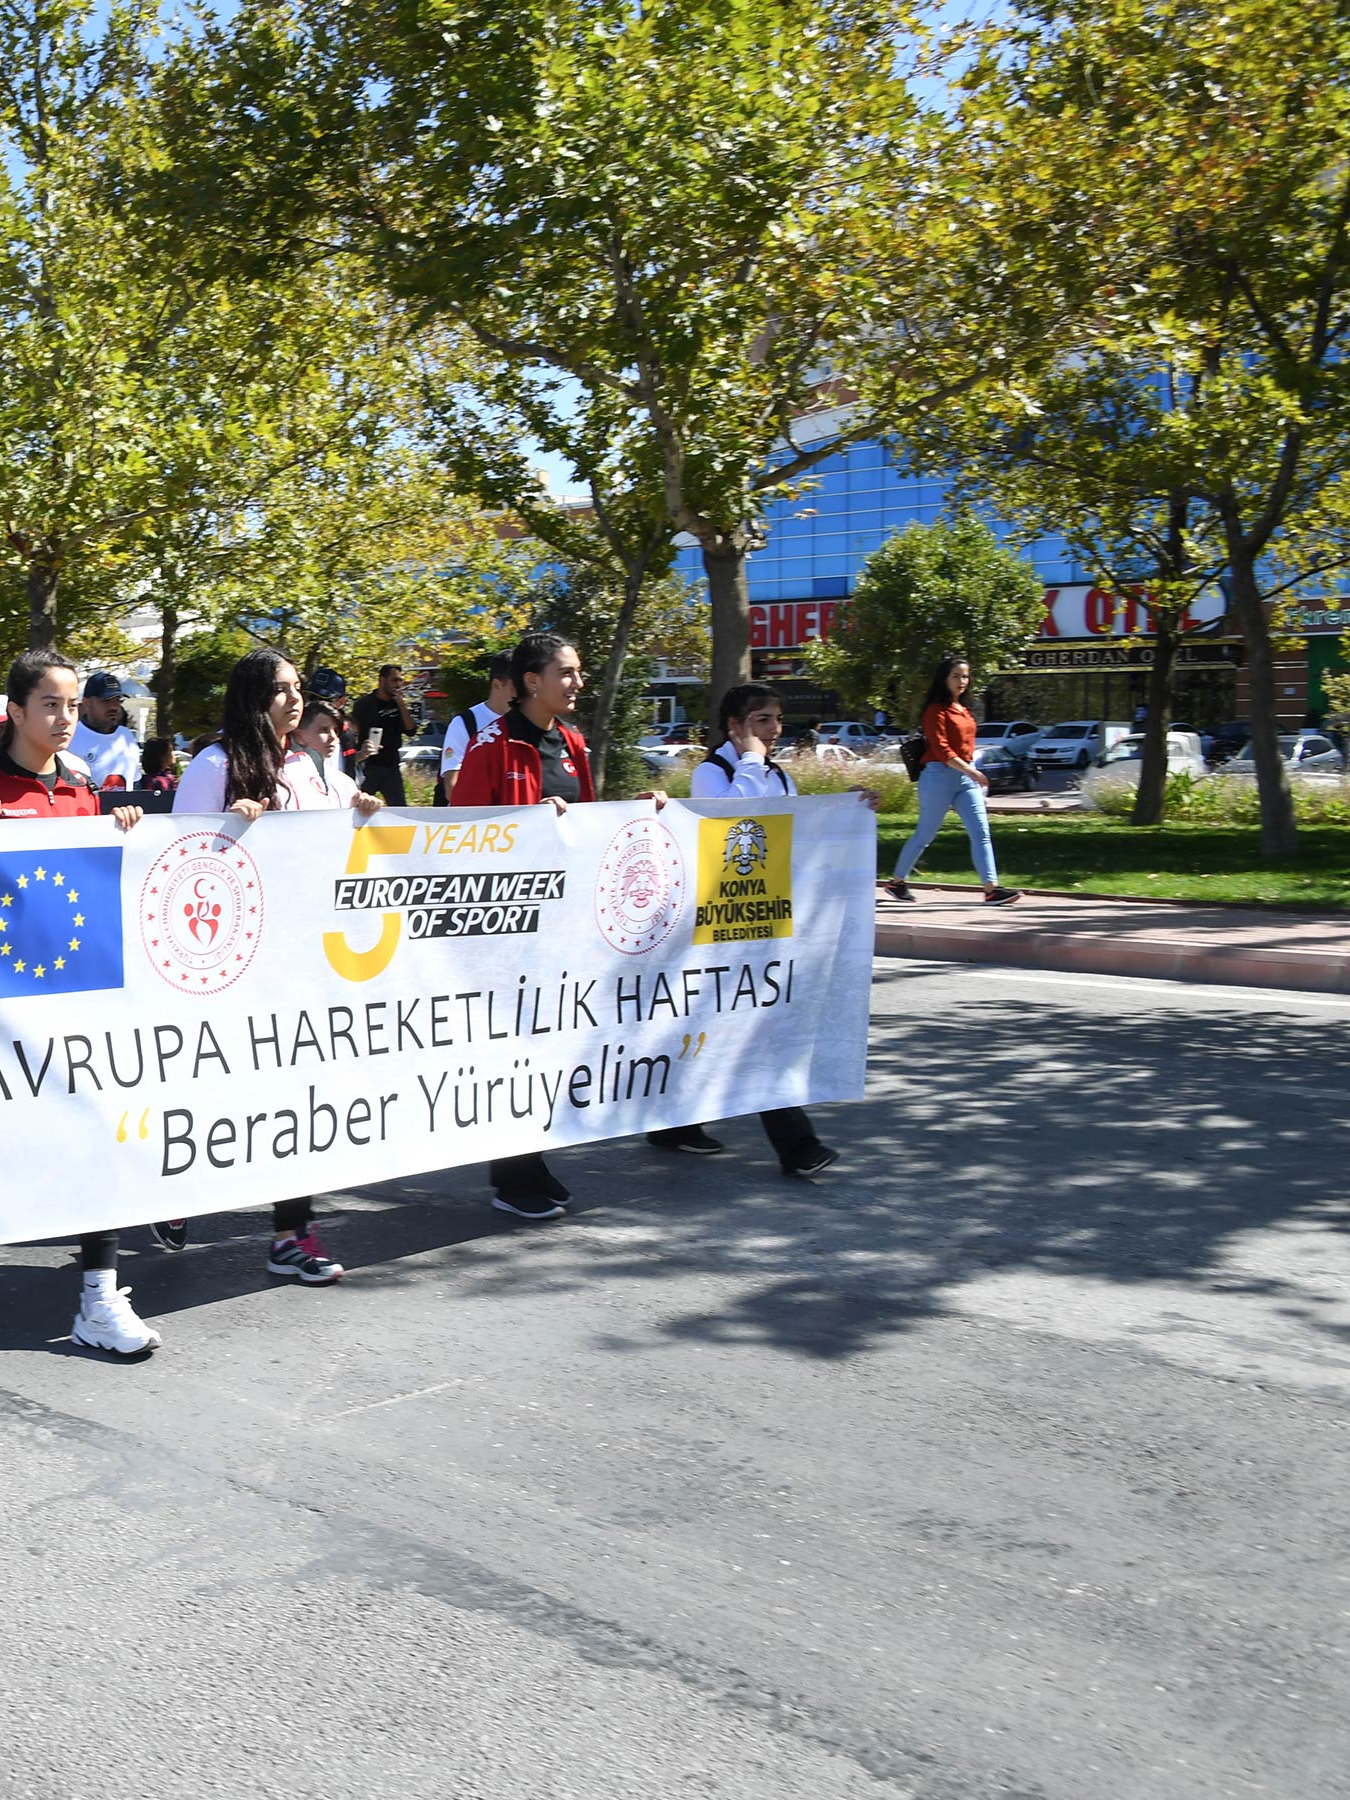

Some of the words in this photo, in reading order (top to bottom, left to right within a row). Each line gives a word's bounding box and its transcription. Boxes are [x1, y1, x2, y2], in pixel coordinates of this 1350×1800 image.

[1030, 650, 1130, 666] GHERDAN
[422, 823, 520, 855] YEARS
[335, 875, 489, 910] EUROPEAN
[487, 871, 566, 901] WEEK
[719, 879, 767, 898] KONYA
[409, 908, 449, 938] OF
[445, 904, 540, 935] SPORT
[695, 895, 793, 927] BÜYÜKŞEHİR
[713, 922, 774, 942] BELEDİYESİ
[248, 971, 598, 1070] HAREKETLİLİK
[616, 959, 794, 1024] HAFTASI
